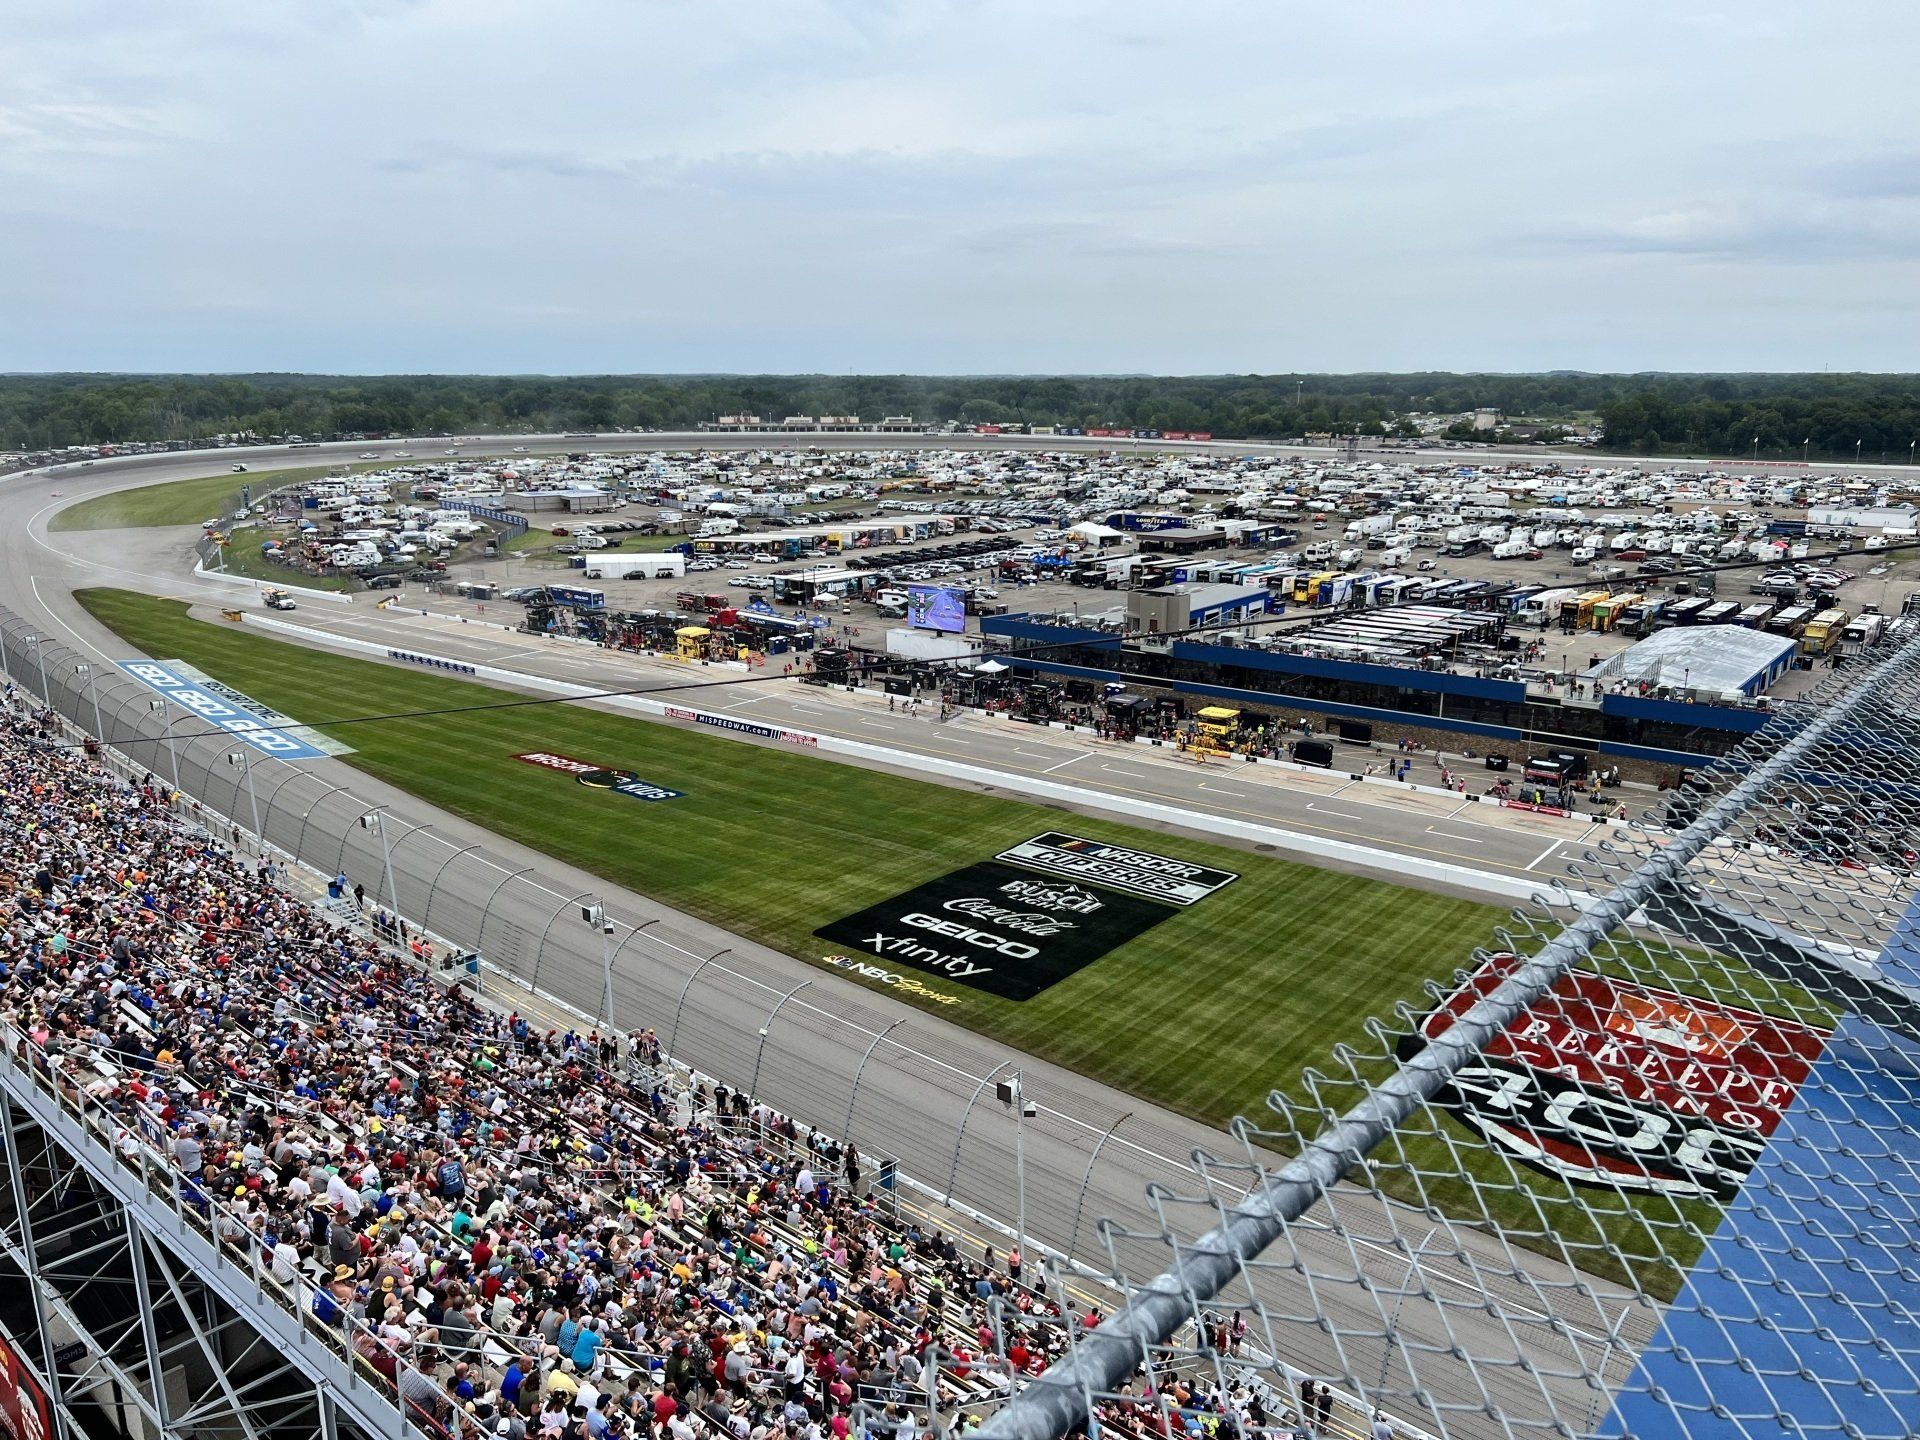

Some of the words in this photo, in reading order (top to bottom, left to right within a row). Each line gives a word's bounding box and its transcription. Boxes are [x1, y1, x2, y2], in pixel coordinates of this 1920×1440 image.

[126, 664, 185, 687] GEICO
[167, 690, 238, 716] GEICO
[220, 719, 301, 751] GEICO
[519, 752, 601, 773] NASCAR
[616, 783, 677, 799] KIDS
[1032, 850, 1090, 869] CUP
[1085, 860, 1187, 892] SERIES
[1089, 847, 1204, 879] NASCAR
[997, 880, 1105, 914] BUSCH
[1007, 894, 1066, 911] LIGHT
[899, 912, 1040, 959] GEICO
[861, 932, 994, 977] xfinity
[849, 962, 903, 985] NBC
[894, 978, 963, 1005] Sports
